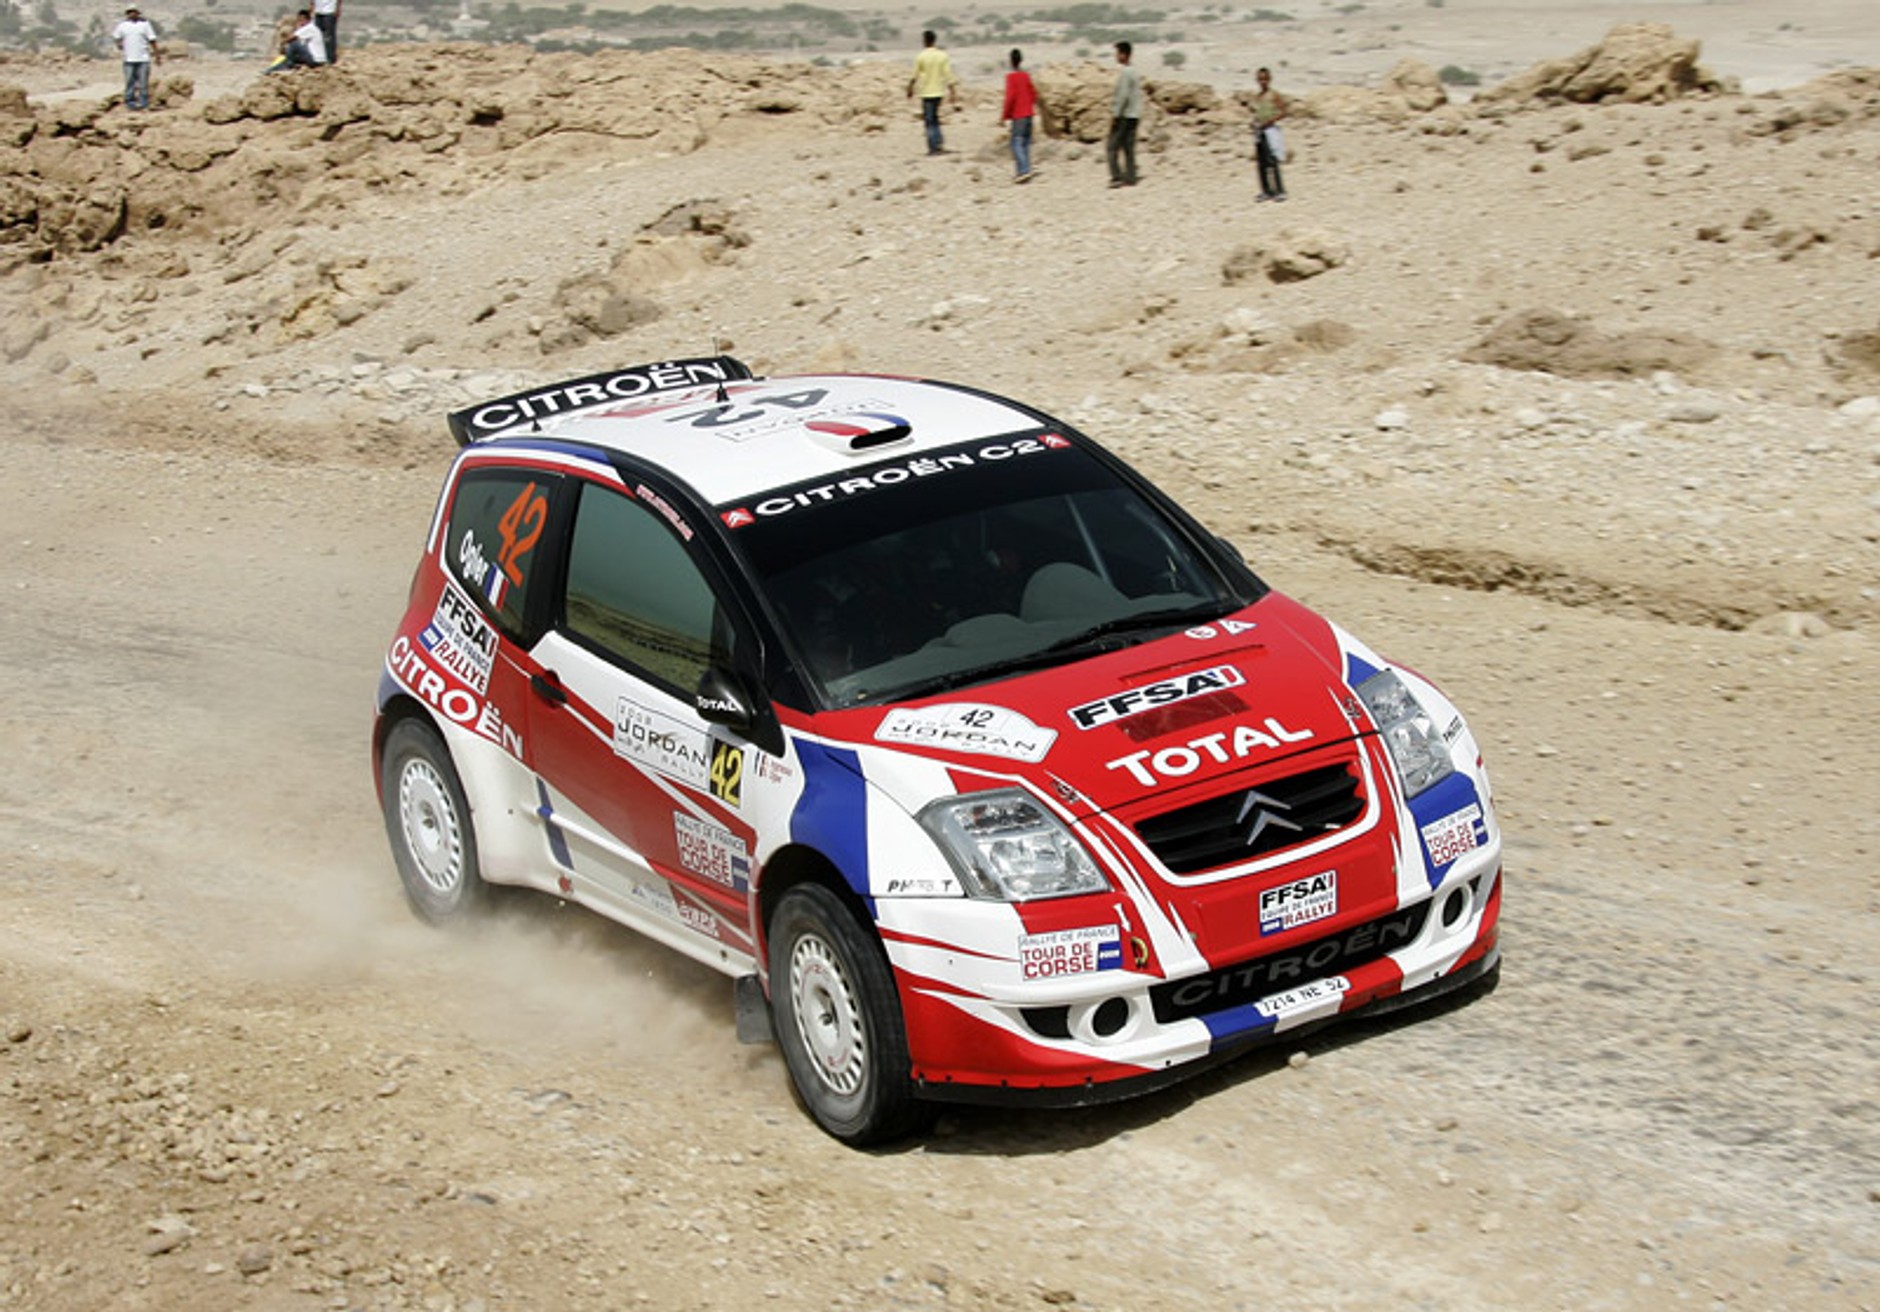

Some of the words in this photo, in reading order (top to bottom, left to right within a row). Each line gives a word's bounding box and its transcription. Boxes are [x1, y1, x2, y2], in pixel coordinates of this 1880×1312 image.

[472, 362, 727, 429] CITROËN
[755, 453, 975, 516] CITROËN
[979, 439, 1047, 461] C2
[498, 481, 548, 588] 42
[435, 640, 486, 692] RALLYE
[390, 636, 523, 759] CITROËN
[960, 709, 995, 728] 42
[618, 718, 707, 768] JORDAN
[891, 723, 1036, 751] JORDAN
[1104, 717, 1315, 787] TOTAL
[710, 743, 743, 808] 42
[1427, 829, 1456, 850] TOUR
[1431, 829, 1476, 865] CORSE
[1284, 901, 1334, 926] RALLYE
[1022, 945, 1066, 961] TOUR
[1071, 941, 1093, 956] DE
[1024, 954, 1094, 979] CORSE
[1171, 916, 1412, 1006] CITROËN
